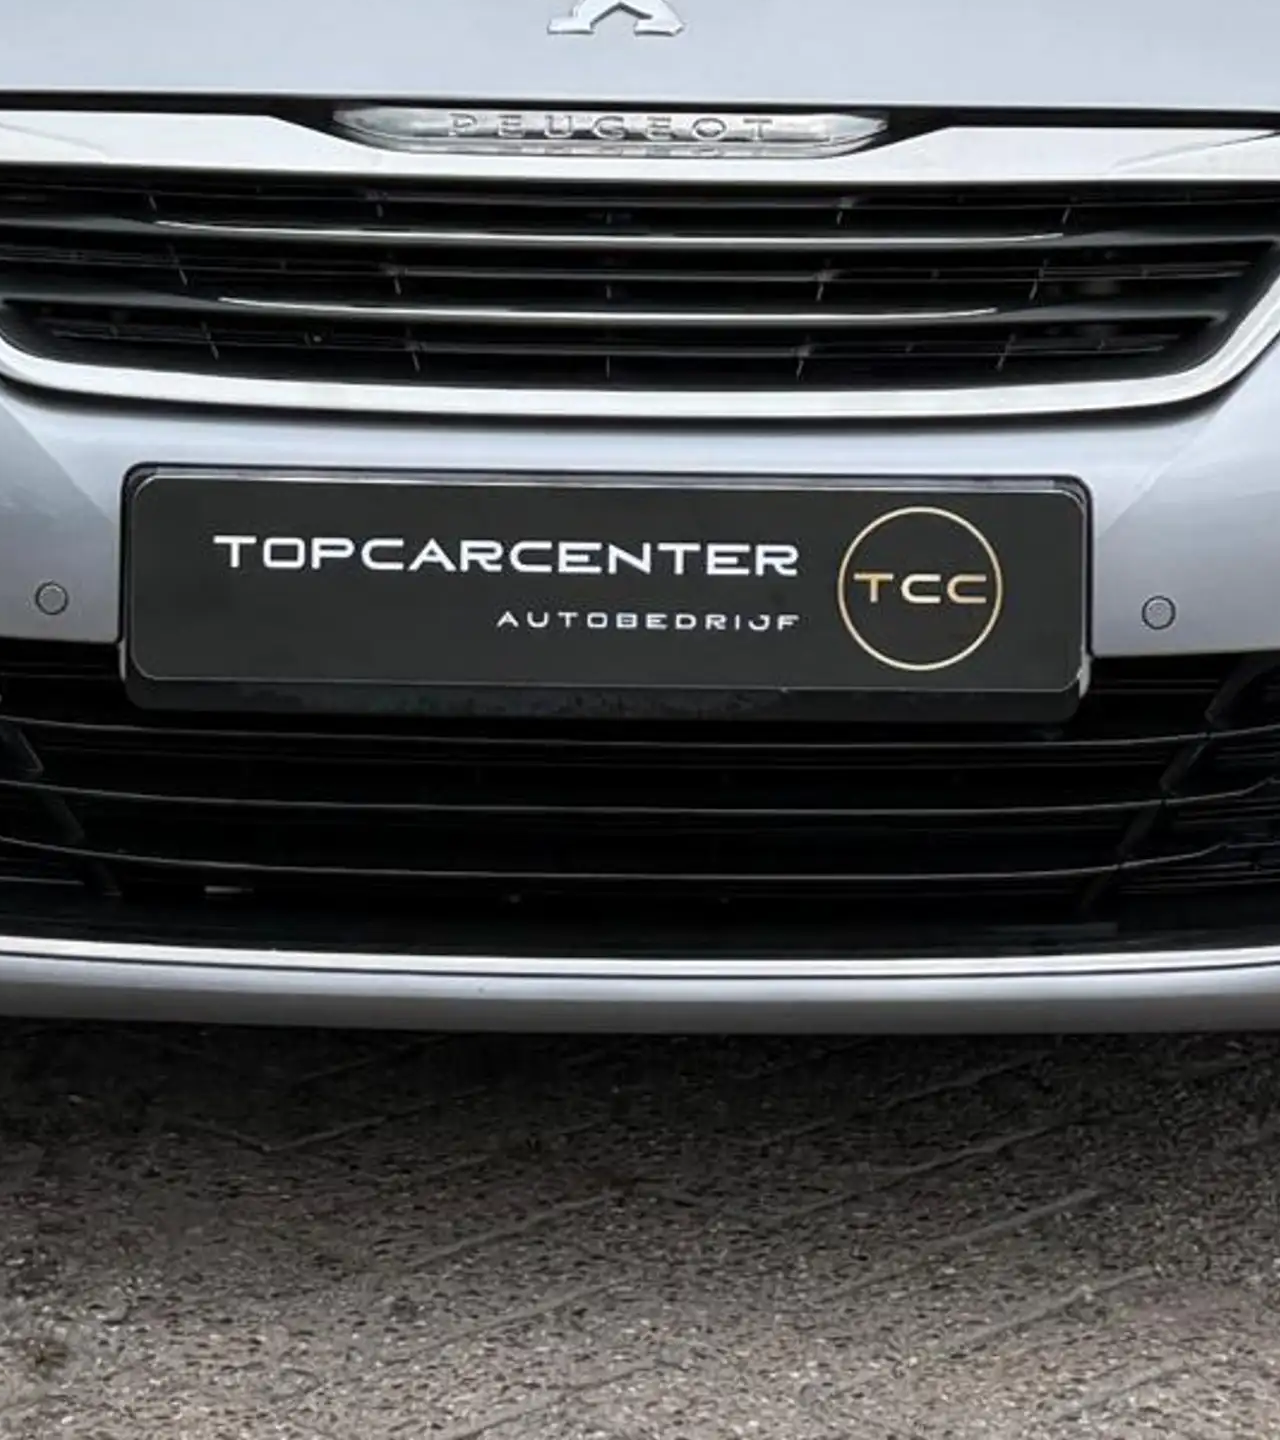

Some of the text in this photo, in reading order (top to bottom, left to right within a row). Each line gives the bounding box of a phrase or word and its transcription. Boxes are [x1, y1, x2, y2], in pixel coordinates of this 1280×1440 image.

[448, 112, 773, 141] PEUGEOT
[213, 535, 800, 577] TOPCARCENTER
[853, 572, 987, 604] TCC
[496, 610, 800, 631] AUTOBEDRIJF
